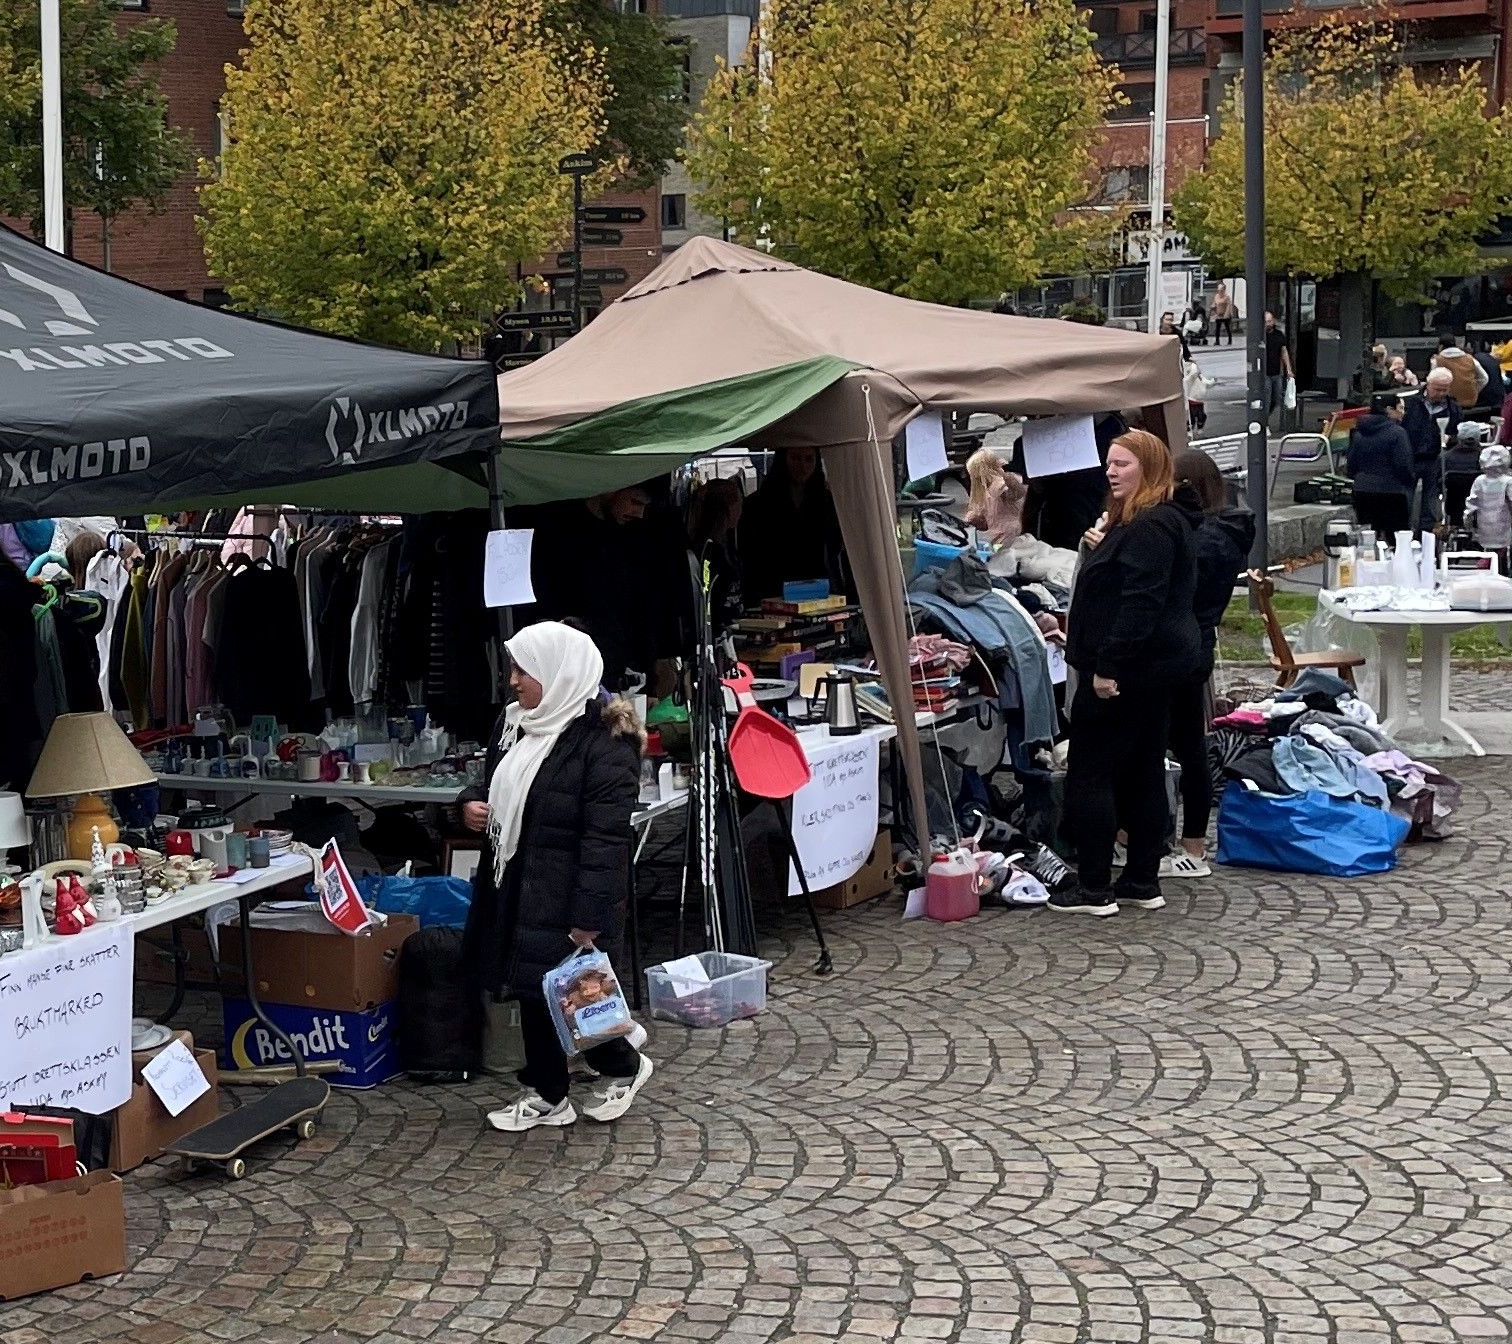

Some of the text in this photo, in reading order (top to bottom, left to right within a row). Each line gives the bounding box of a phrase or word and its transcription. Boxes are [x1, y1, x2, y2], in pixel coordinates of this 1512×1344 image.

[368, 401, 470, 444] XLMOTO
[6, 436, 152, 488] XLMOTO
[14, 992, 104, 1040] BRUKTMARKED
[254, 1014, 351, 1064] Bendit
